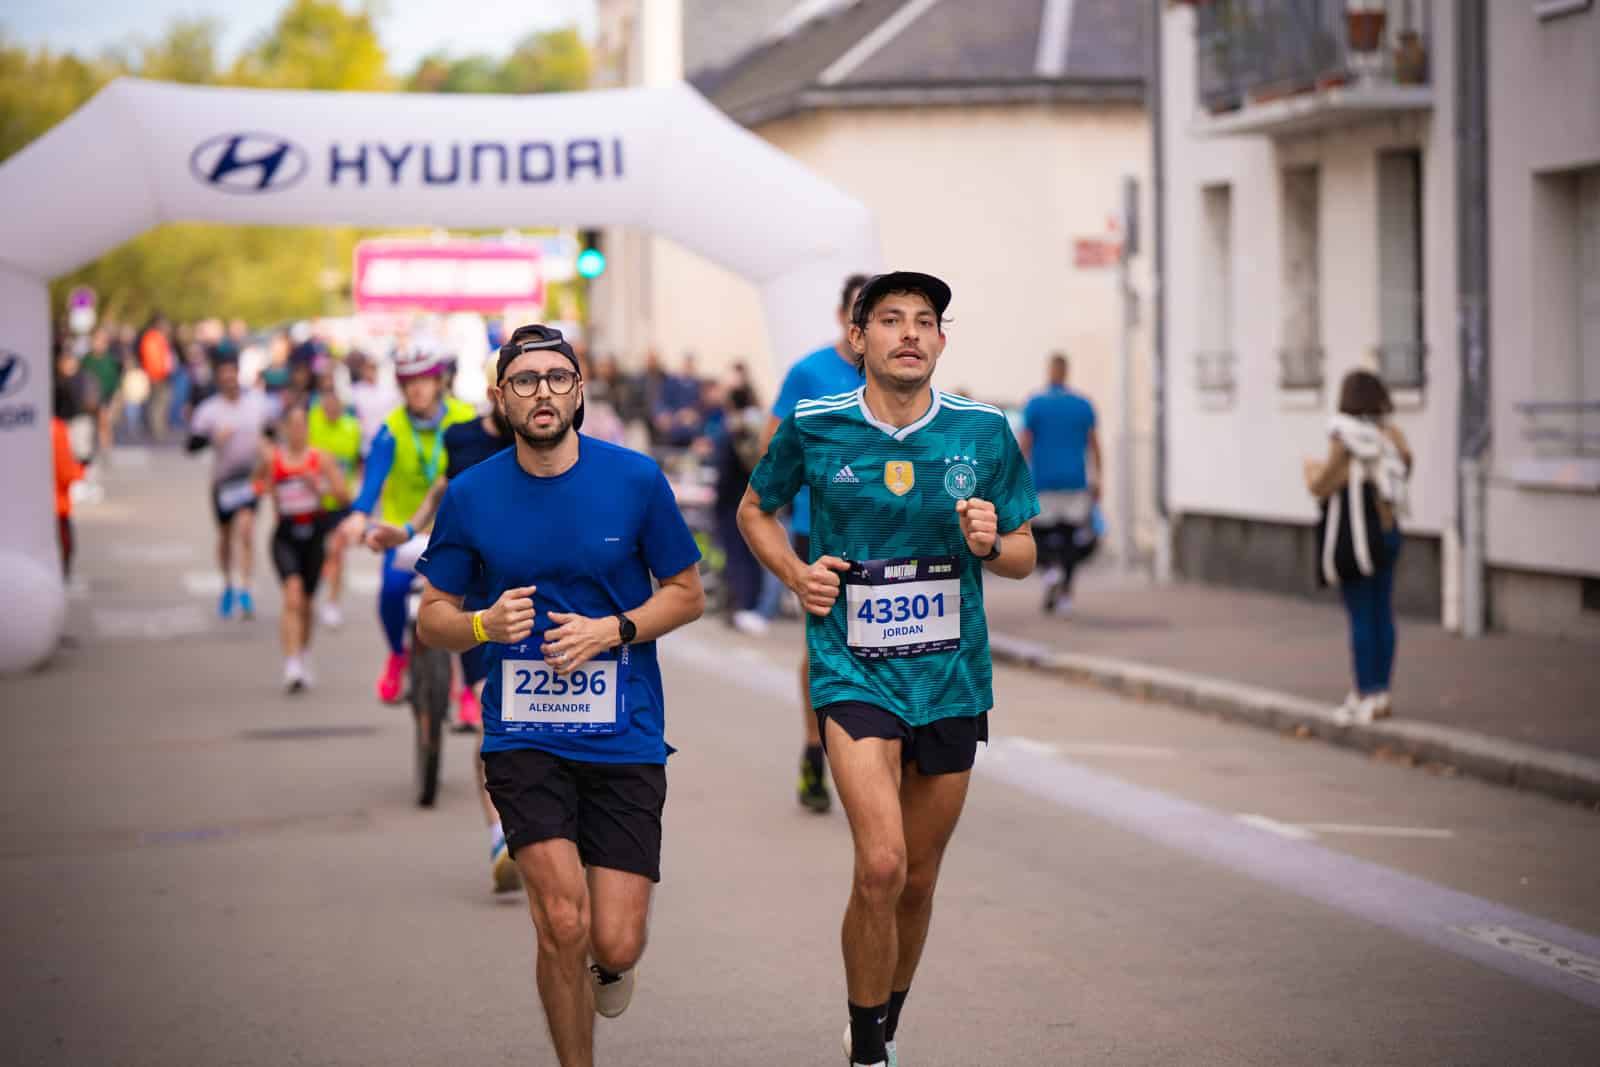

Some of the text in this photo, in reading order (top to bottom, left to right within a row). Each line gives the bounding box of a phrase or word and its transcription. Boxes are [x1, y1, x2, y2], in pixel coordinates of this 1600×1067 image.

[328, 138, 624, 186] HYUNDAI
[857, 592, 944, 624] 43301
[882, 624, 924, 640] JORDAN
[514, 669, 606, 696] 22596
[529, 703, 591, 713] ALEXANDRE
